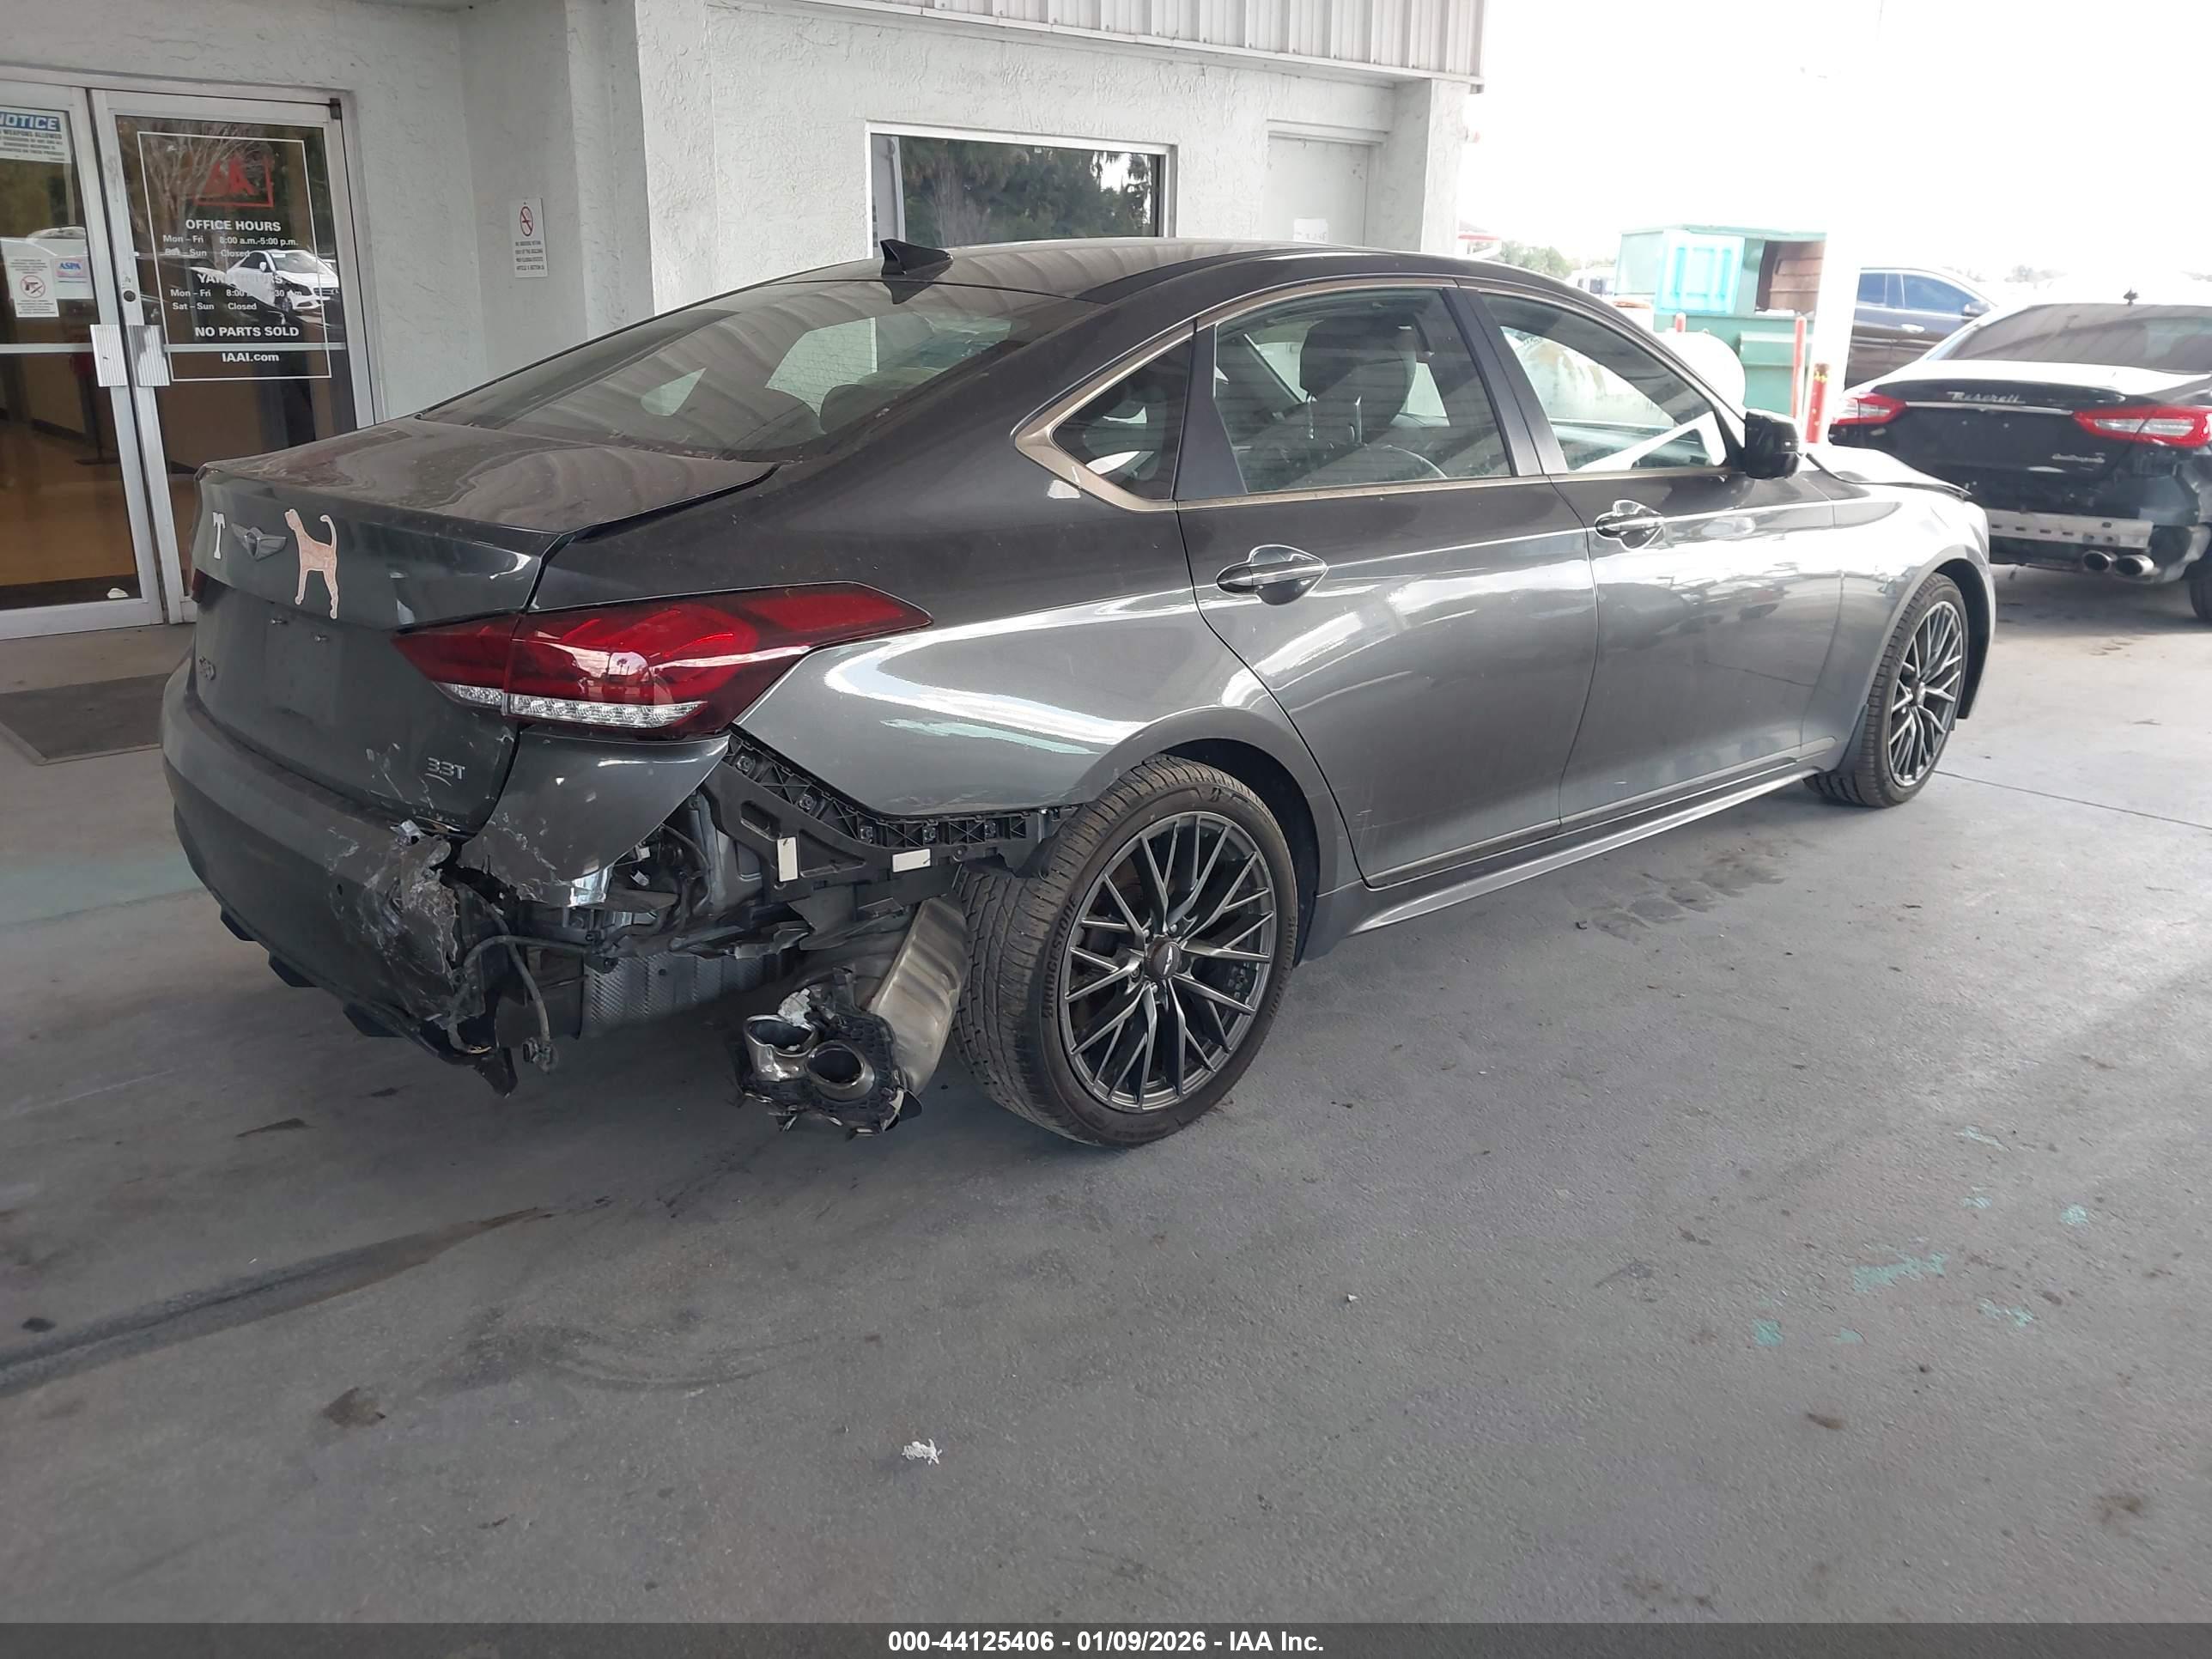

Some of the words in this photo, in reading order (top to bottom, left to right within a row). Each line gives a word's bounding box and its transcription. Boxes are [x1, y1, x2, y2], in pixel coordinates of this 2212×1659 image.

[185, 219, 232, 230] OFFICE
[235, 221, 282, 232] HOURS
[192, 235, 204, 244] Fri
[220, 249, 251, 258] Closed
[170, 289, 191, 297] Mon
[194, 326, 215, 337] NO
[218, 326, 261, 337] PARTS
[264, 326, 299, 337] SOLD
[222, 352, 280, 362] IAAI.com
